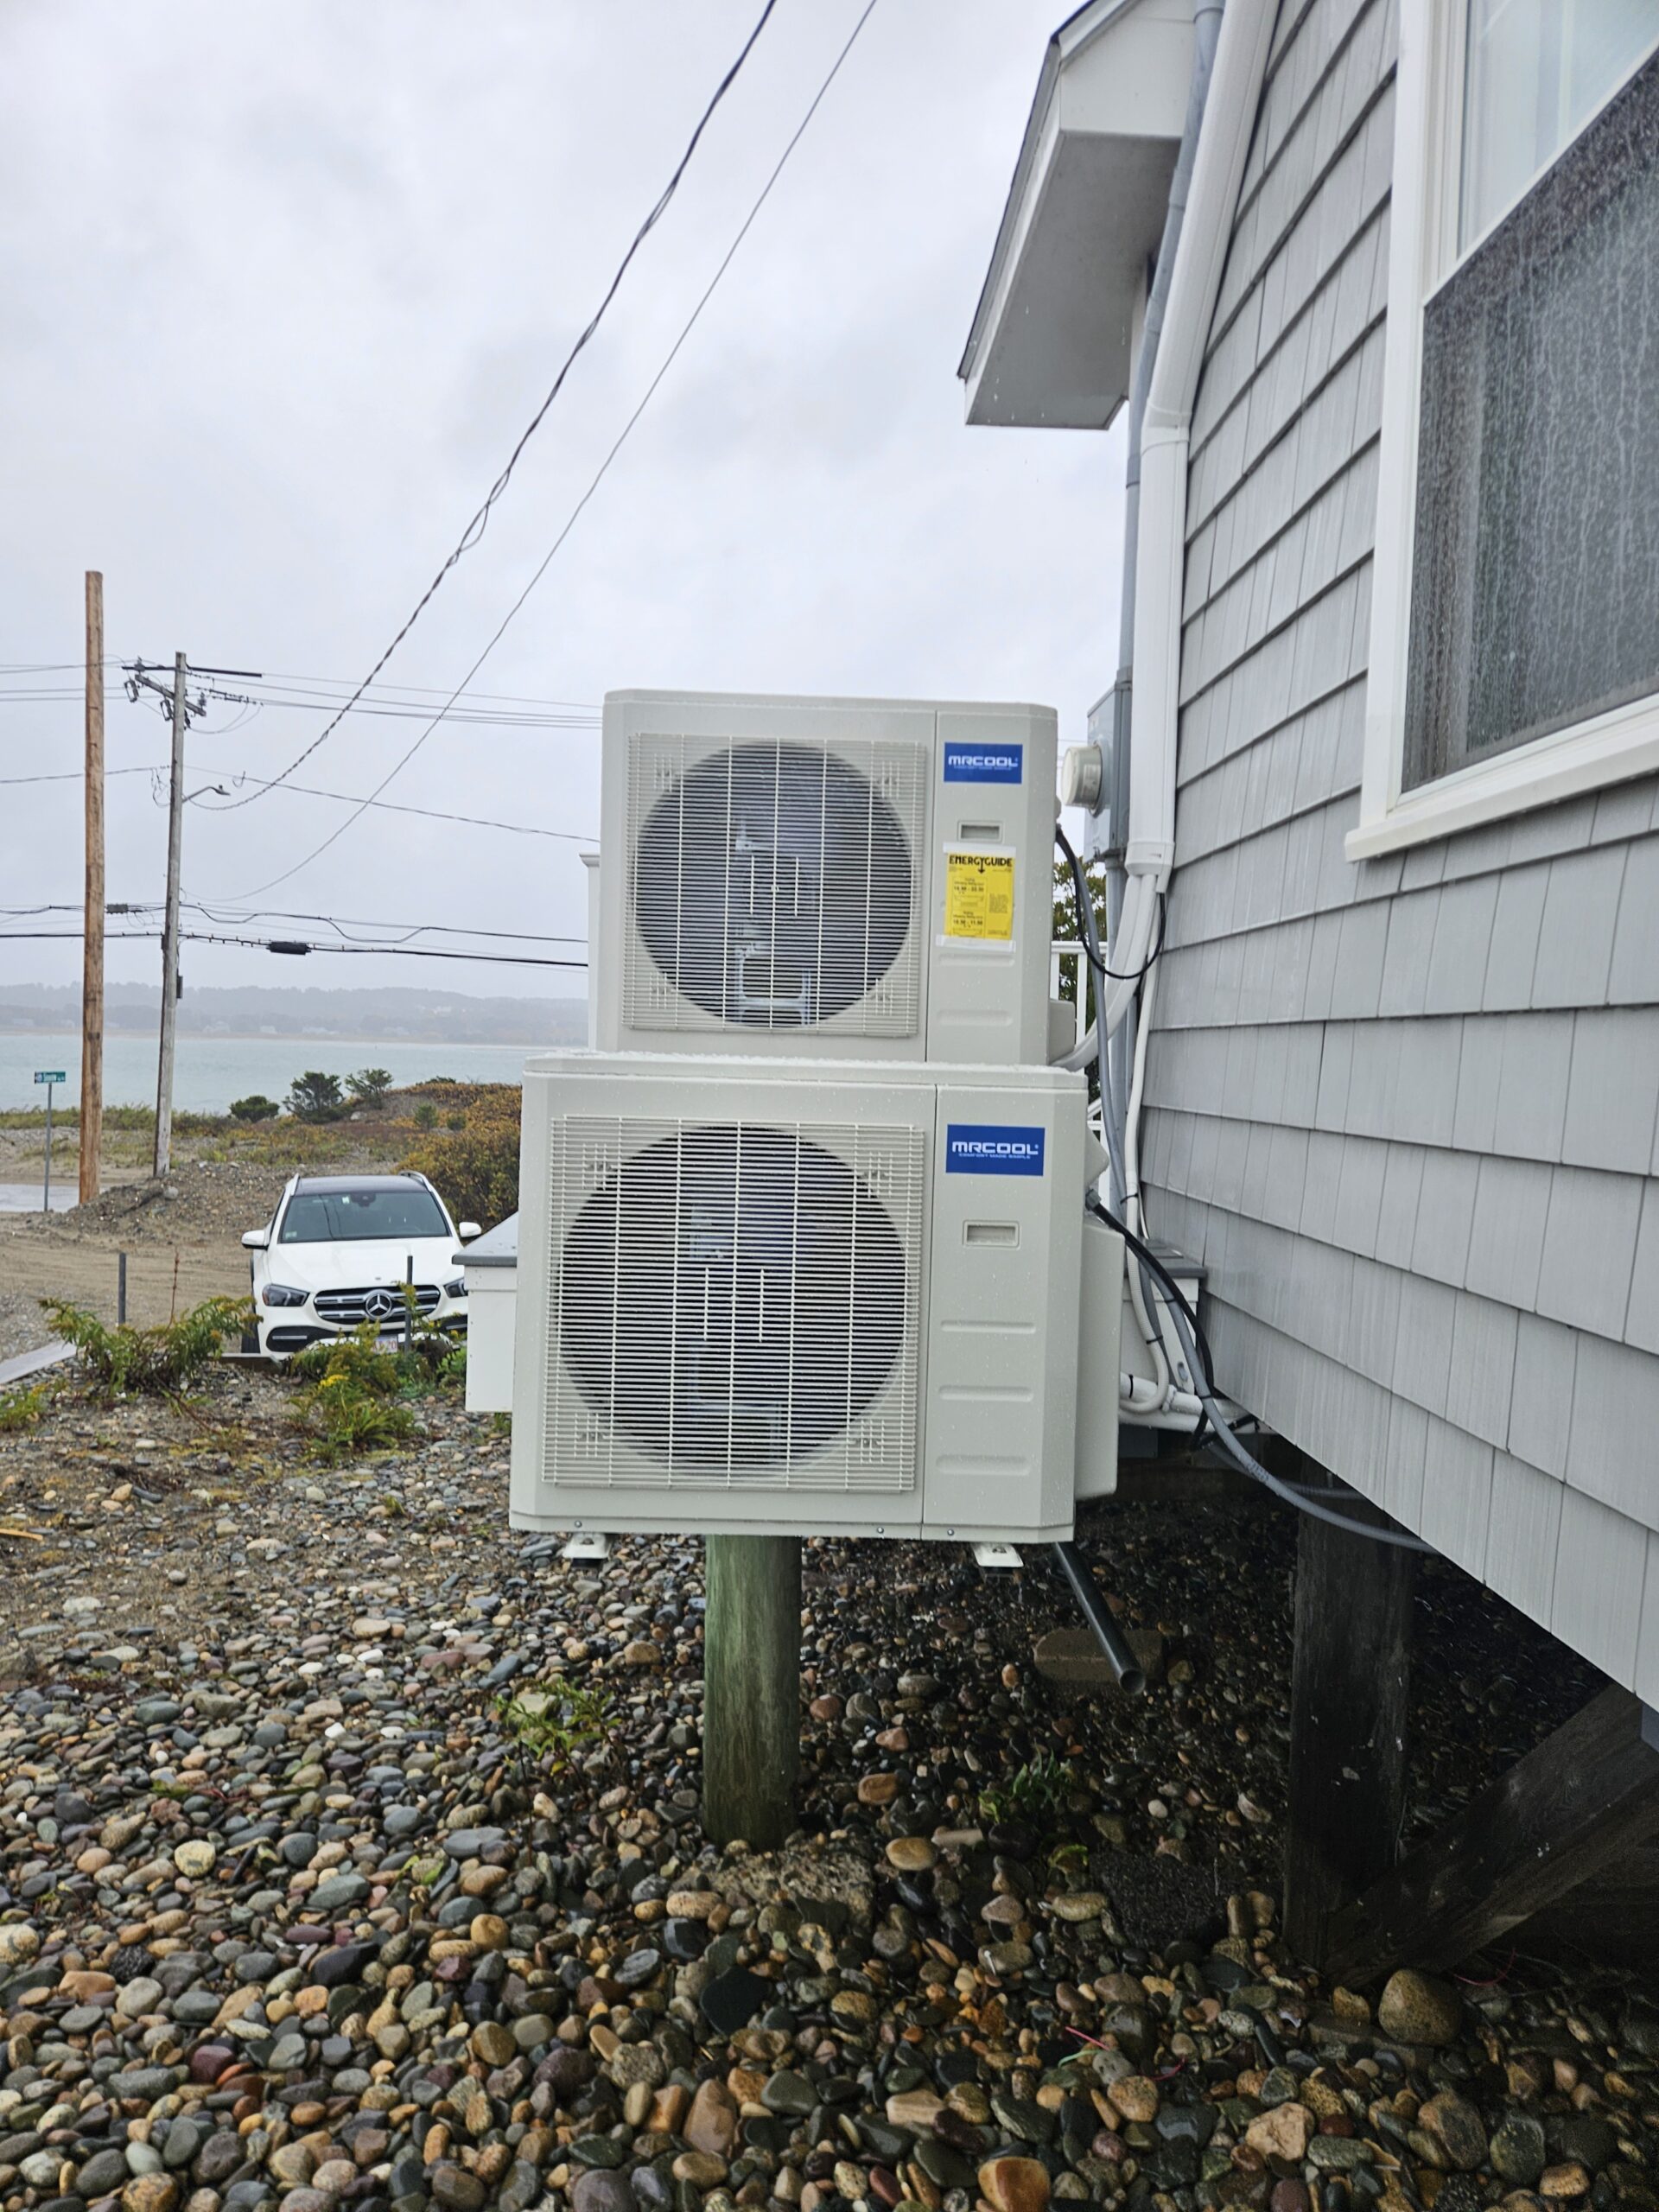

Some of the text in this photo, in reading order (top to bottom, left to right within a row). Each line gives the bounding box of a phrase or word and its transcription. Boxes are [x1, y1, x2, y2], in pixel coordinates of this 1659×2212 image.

[948, 755, 1019, 767] MRCOOL
[949, 855, 1013, 868] ENERGYGUIDE
[952, 1141, 1039, 1154] MRCOOL
